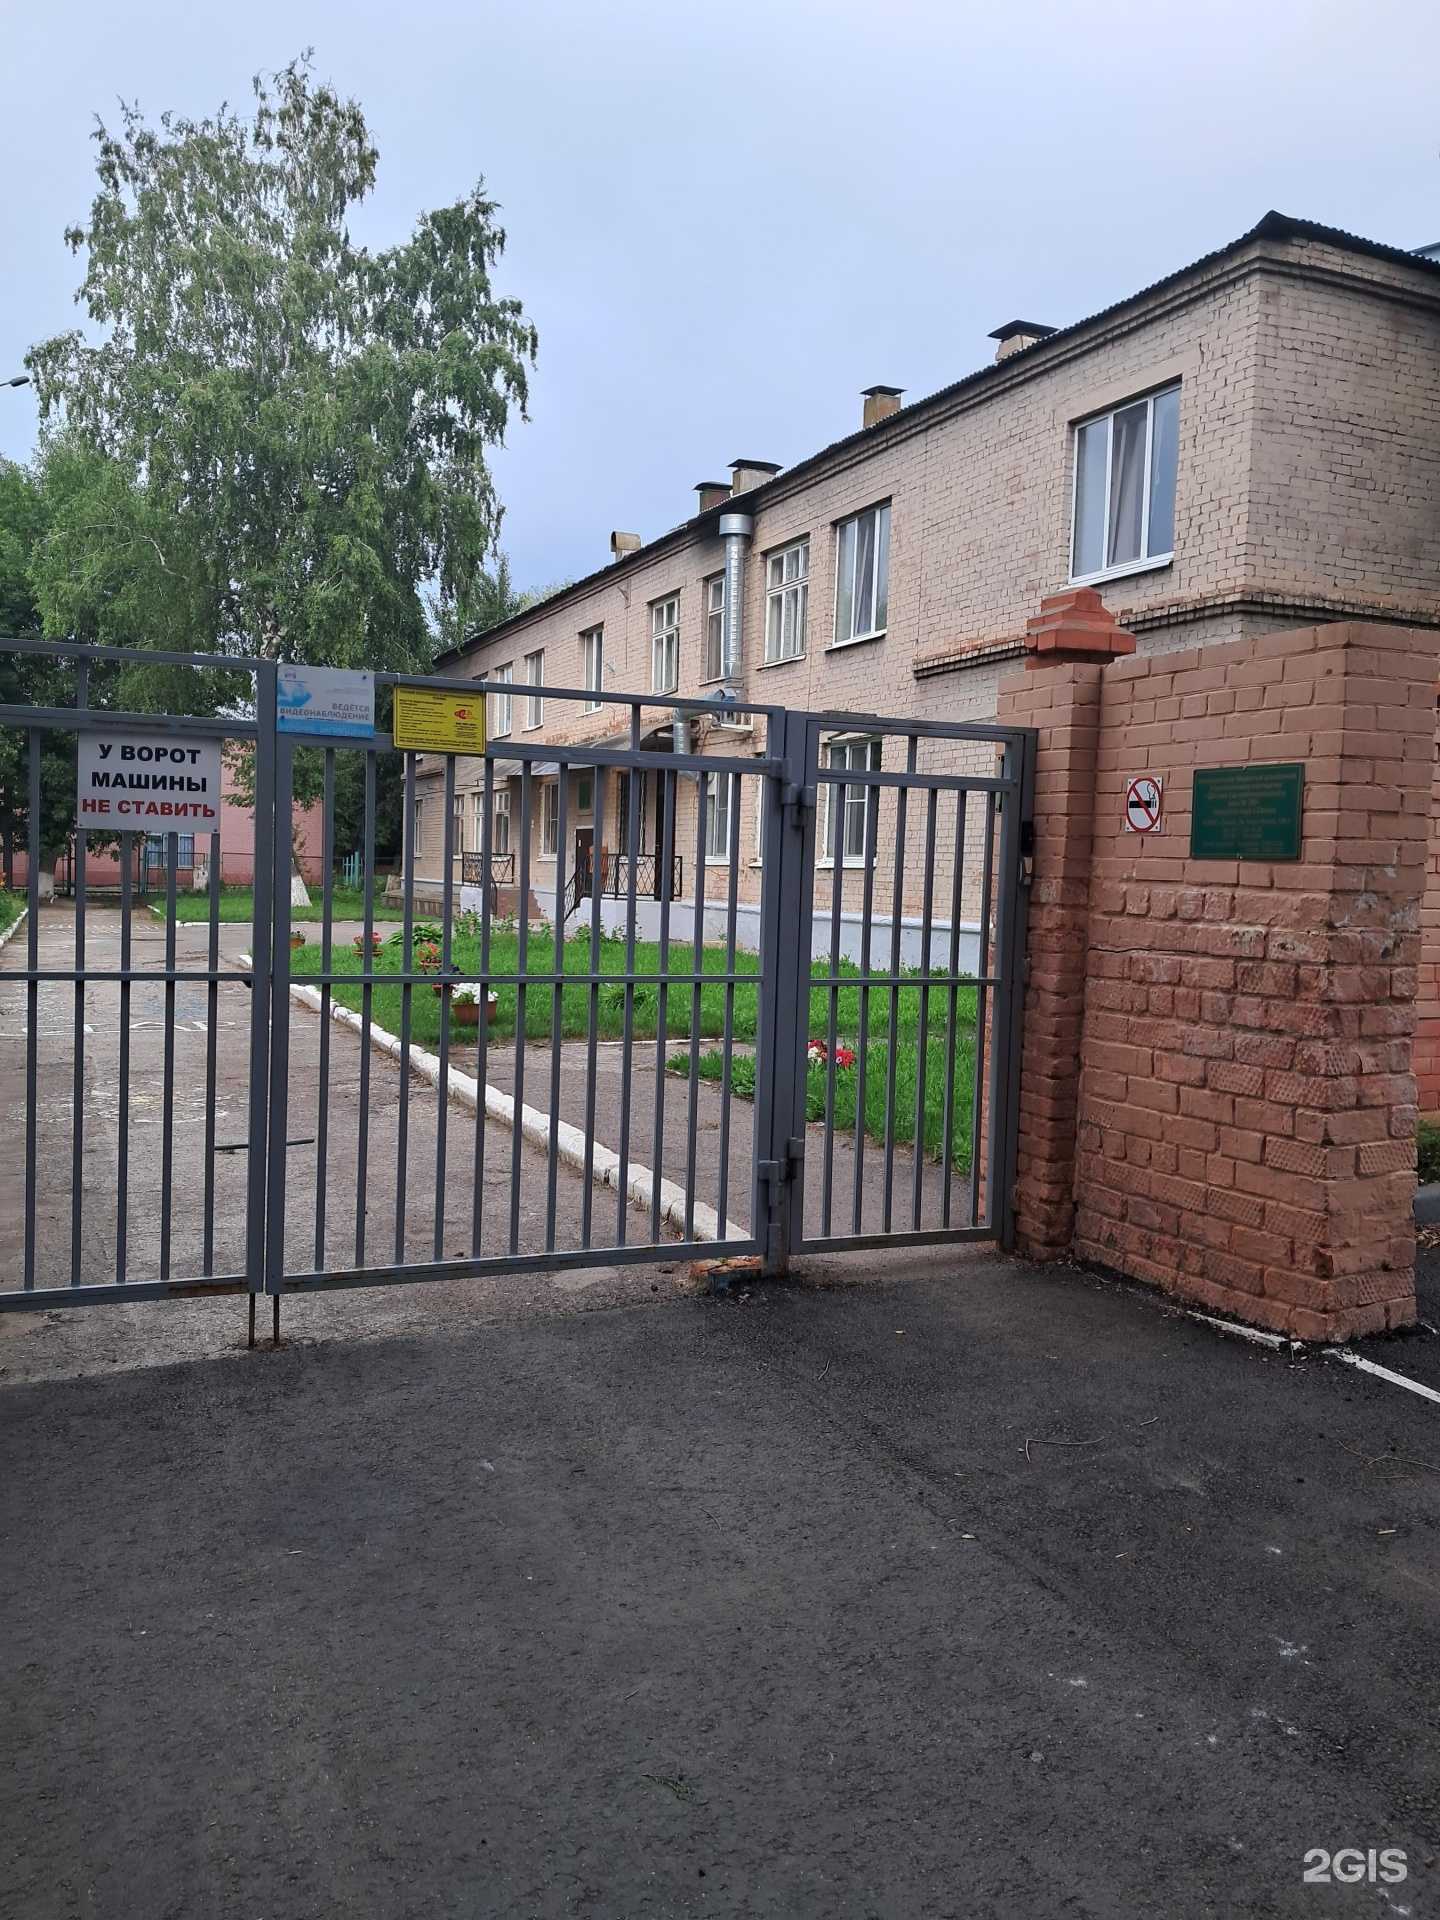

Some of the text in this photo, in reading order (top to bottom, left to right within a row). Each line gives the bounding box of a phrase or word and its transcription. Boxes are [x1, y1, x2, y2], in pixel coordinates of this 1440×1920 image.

[279, 707, 370, 720] ВИДЕОНАБЛЮДЕНИЕ
[98, 743, 201, 764] У ВОРОТ
[91, 772, 207, 792] МАШИНЫ
[82, 798, 216, 818] НЕ СТАВИТЬ
